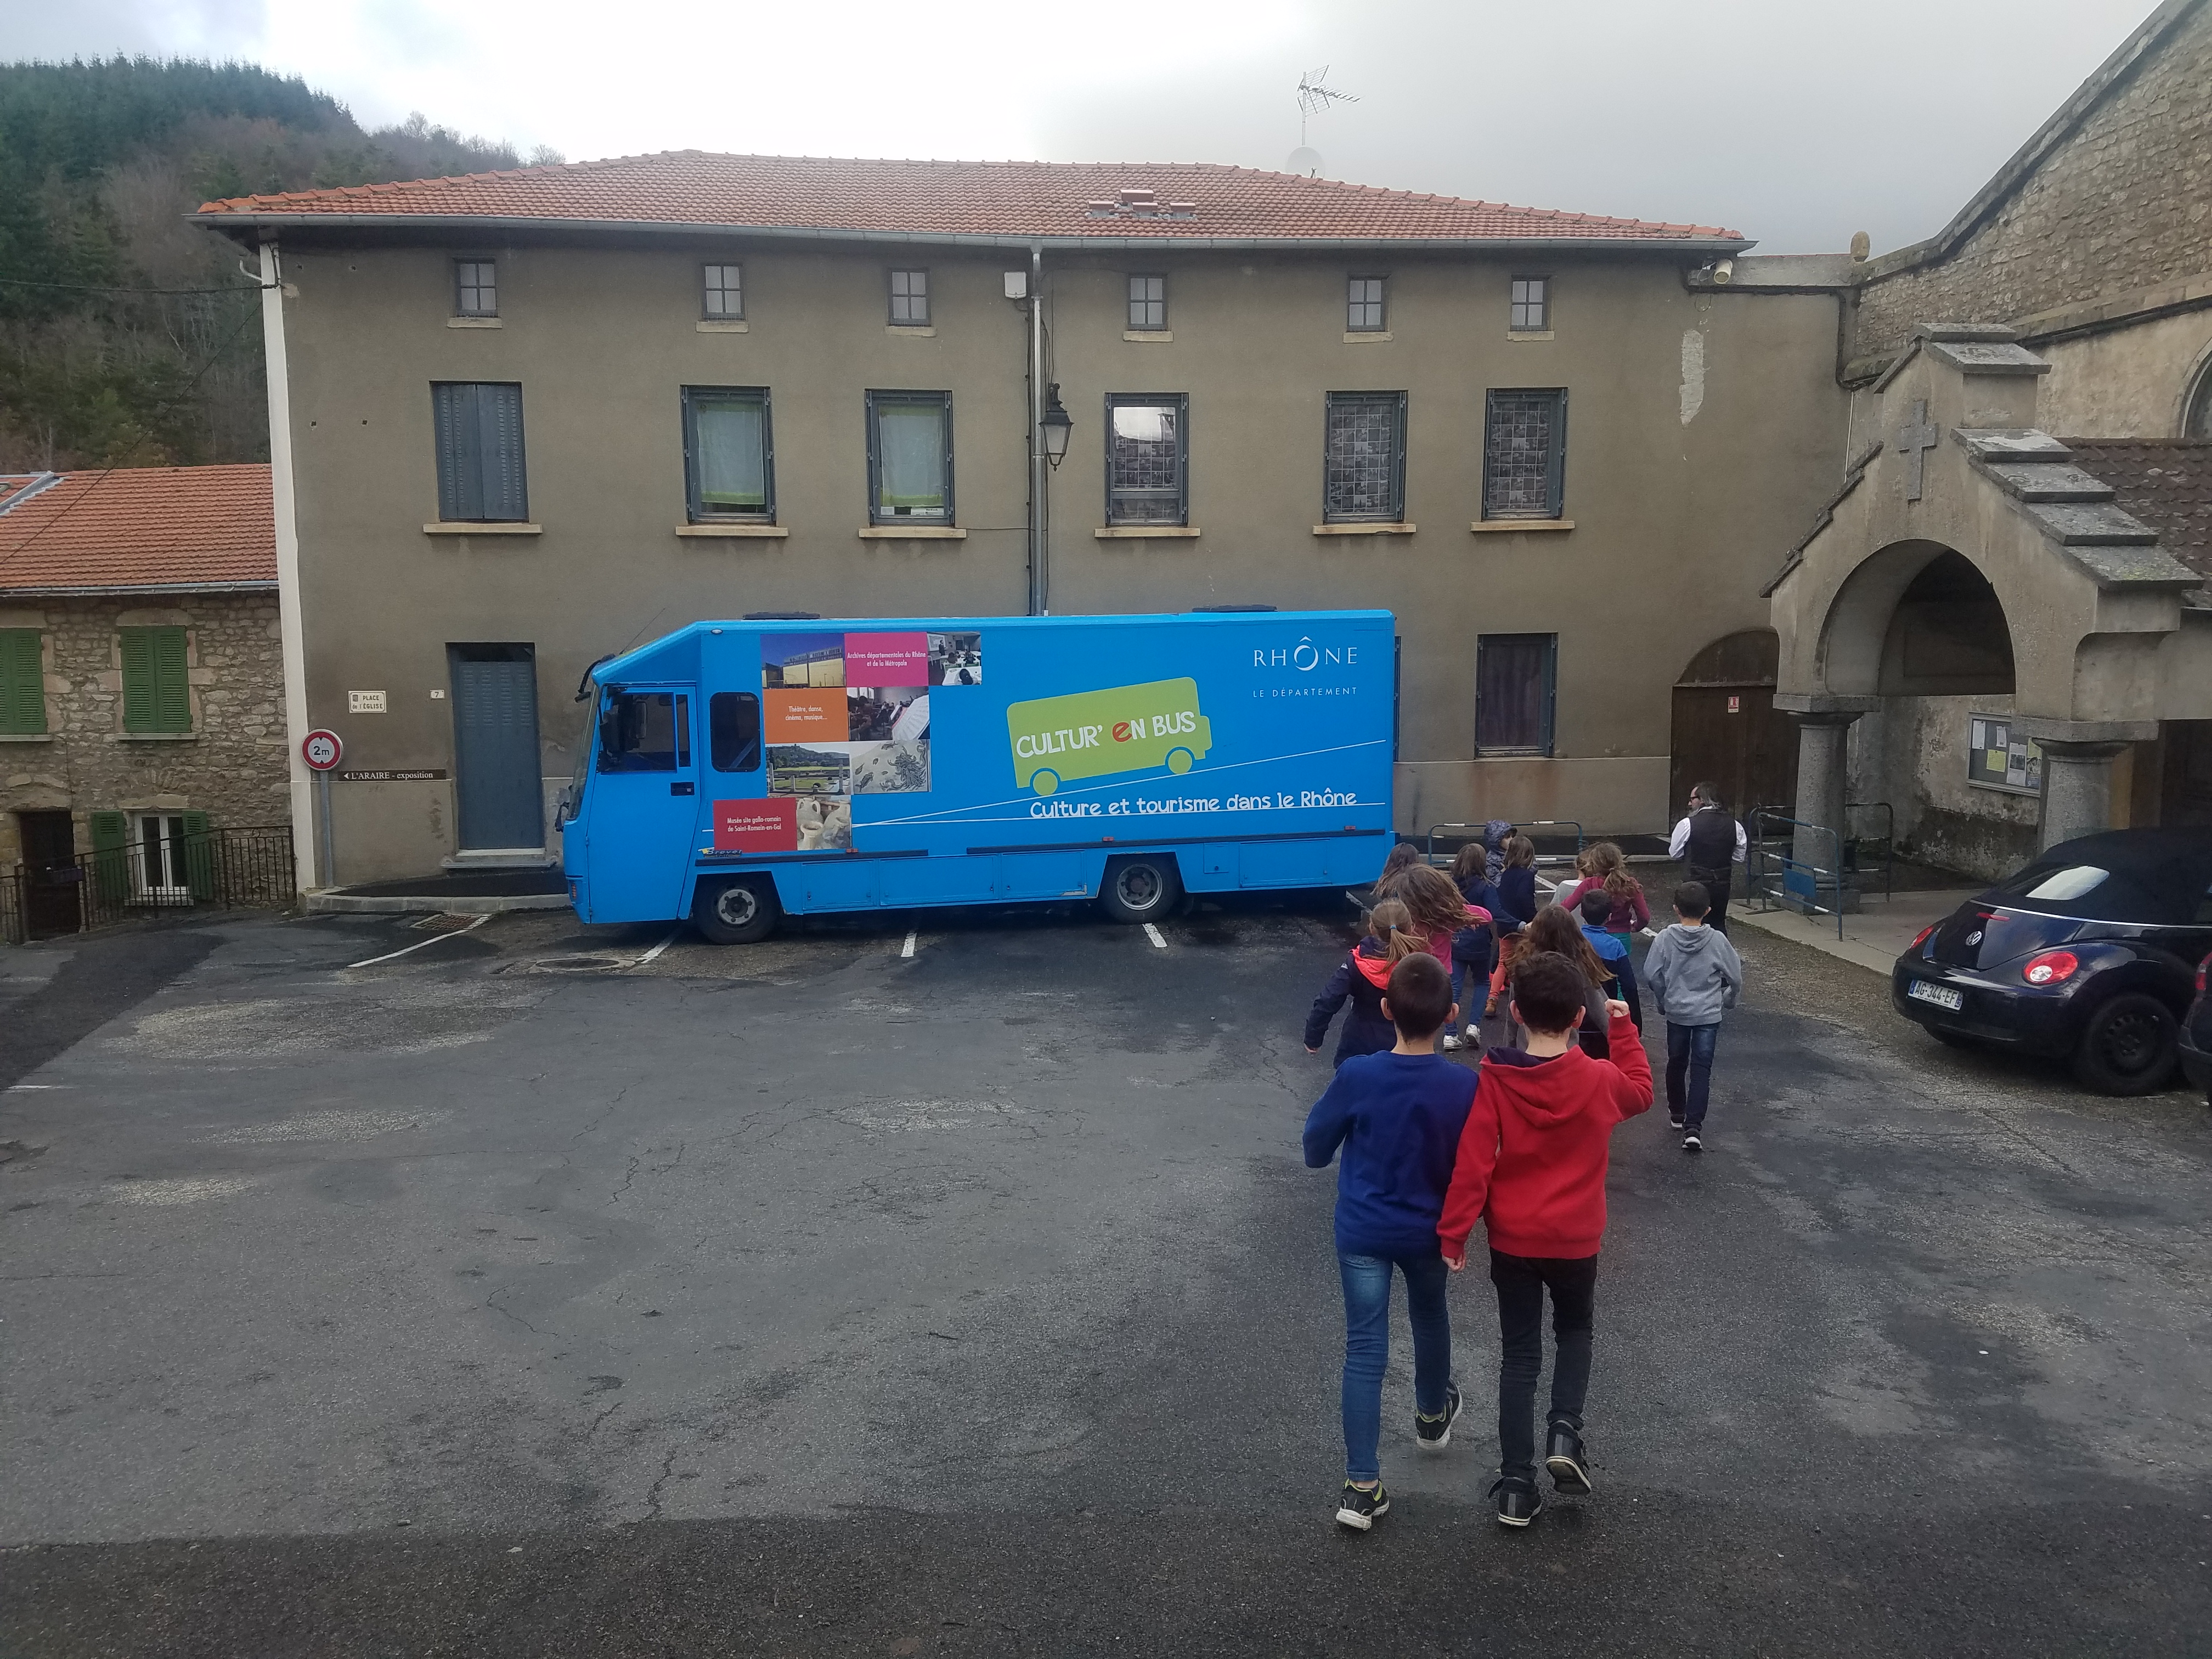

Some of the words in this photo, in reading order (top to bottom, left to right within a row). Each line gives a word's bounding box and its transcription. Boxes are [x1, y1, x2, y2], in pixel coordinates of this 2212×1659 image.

[867, 651, 904, 659] départementales
[1254, 636, 1357, 671] RHÔNE
[1253, 690, 1264, 698] LE
[1272, 687, 1357, 697] DÉPARTEMENT
[1017, 725, 1103, 758] CULTUR'
[1152, 711, 1196, 737] BUS
[397, 771, 433, 780] exposition
[1030, 800, 1102, 818] Culture
[1108, 798, 1130, 815] et
[1136, 797, 1220, 813] tourisme
[1226, 794, 1271, 810] dans
[1277, 792, 1295, 808] le
[1301, 787, 1357, 807] Rhône
[752, 816, 781, 825] gallo-romain
[735, 823, 782, 832] Saint-Romain-en-Gal
[1915, 981, 1958, 1005] AG-344-EF
